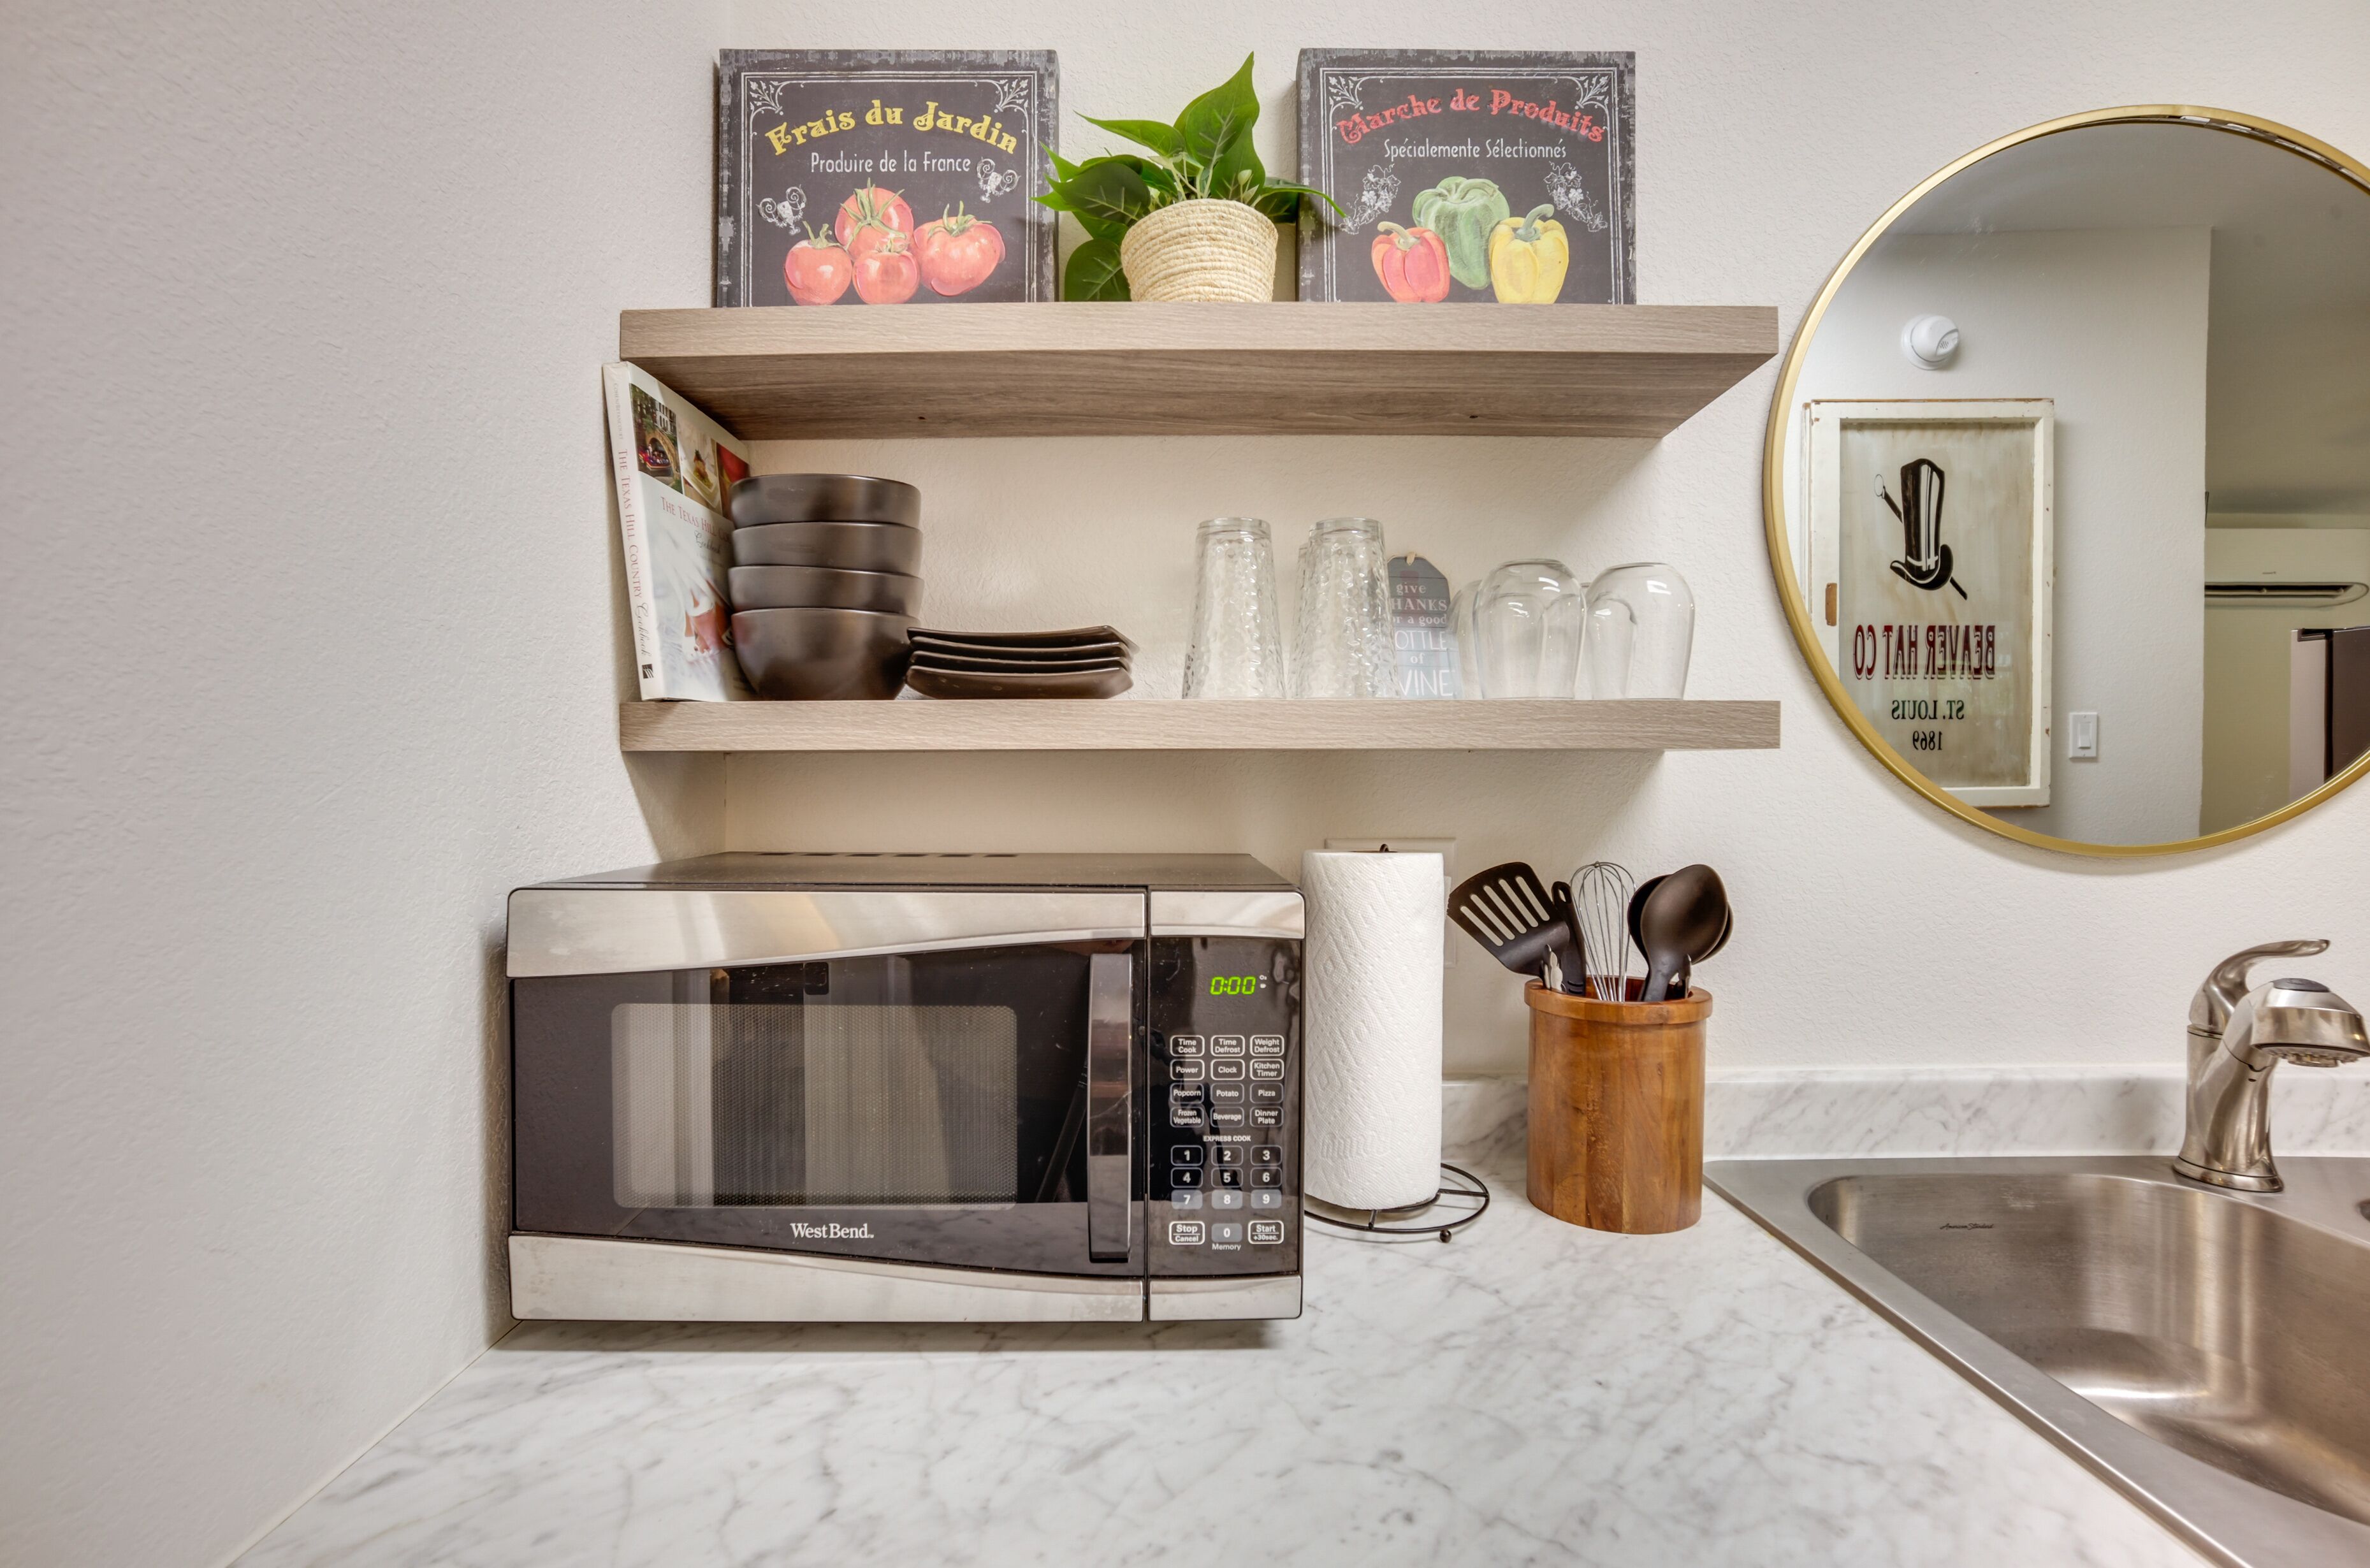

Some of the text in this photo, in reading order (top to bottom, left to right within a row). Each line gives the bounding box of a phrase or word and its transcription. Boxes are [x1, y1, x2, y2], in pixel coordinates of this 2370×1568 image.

[1450, 89, 1480, 112] de
[1491, 89, 1605, 143] Produits
[765, 99, 1018, 155] Frais du Jardin
[1384, 138, 1567, 161] Spécialemente Sélectionnés
[811, 150, 971, 173] Produire de la France
[660, 497, 676, 515] THE
[678, 505, 699, 528] TEXAS
[618, 448, 652, 658] THE TEXAS HILL COUNTRY Cookbook
[1396, 582, 1426, 595] give
[1391, 599, 1448, 611] HANKS
[1407, 616, 1414, 624] a
[1418, 614, 1448, 627] good
[1394, 630, 1448, 650] OTTLE
[1410, 652, 1425, 664] of
[1210, 976, 1256, 995] 0:00
[1254, 1038, 1280, 1047] Weight
[1173, 1089, 1202, 1098] Popcorn
[1213, 1113, 1242, 1121] Beverage
[1184, 1150, 1190, 1161] 1
[1223, 1151, 1231, 1161] 2
[1262, 1150, 1270, 1161] 3
[1182, 1172, 1191, 1183] 4
[1223, 1172, 1231, 1183] 5
[1262, 1172, 1270, 1182] 6
[1183, 1194, 1191, 1205] 7
[1223, 1194, 1231, 1205] 8
[1262, 1194, 1270, 1204] 9
[790, 1223, 828, 1238] West
[1176, 1224, 1198, 1234] Stop
[1223, 1228, 1231, 1238] 0
[1256, 1224, 1276, 1233] Start
